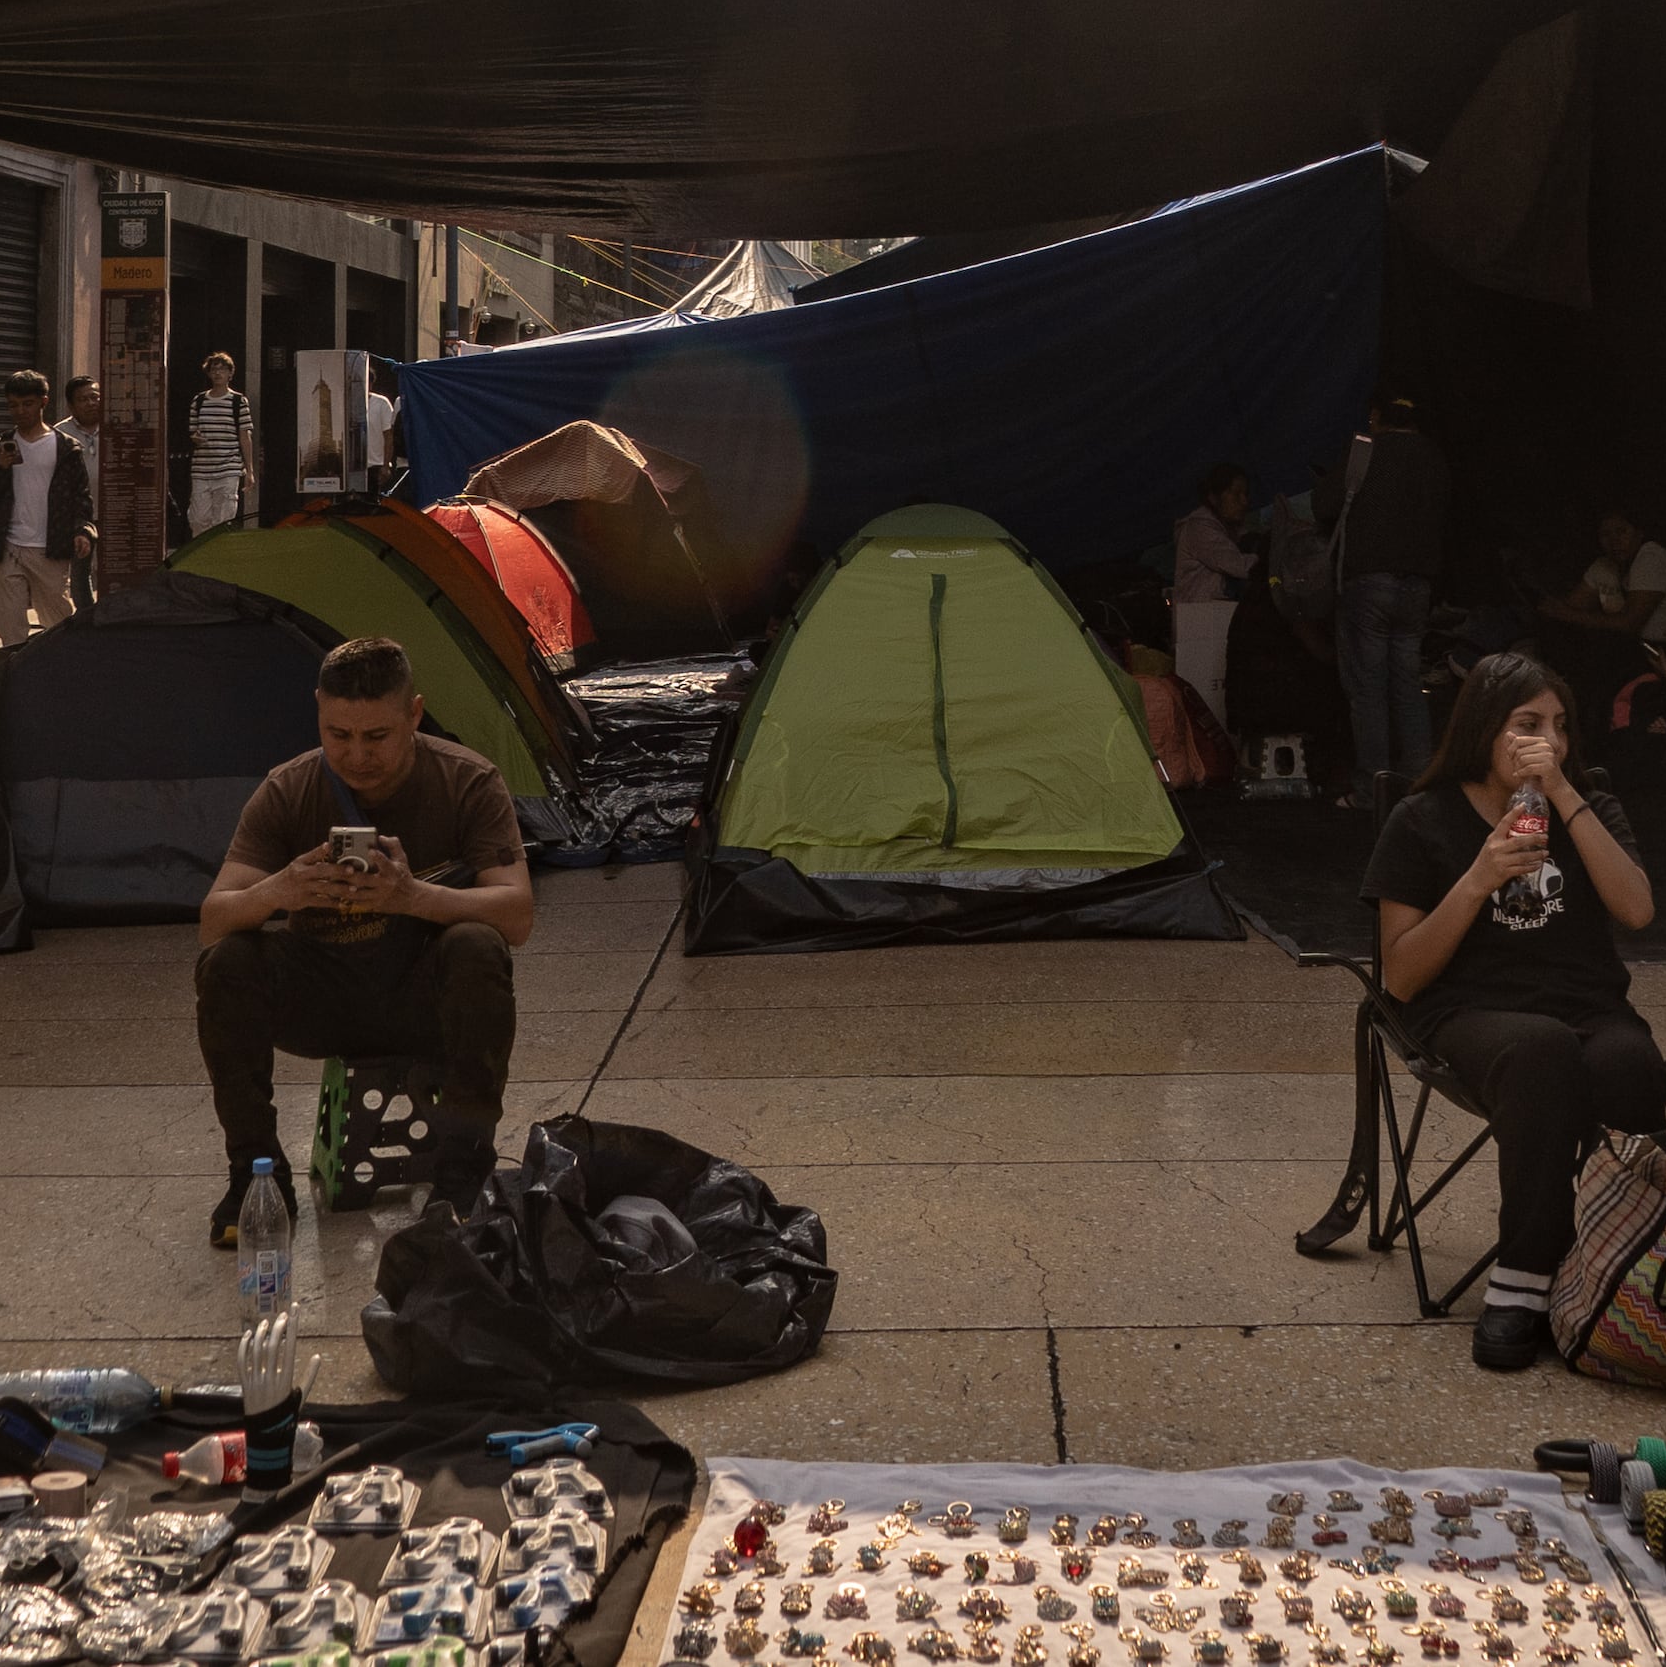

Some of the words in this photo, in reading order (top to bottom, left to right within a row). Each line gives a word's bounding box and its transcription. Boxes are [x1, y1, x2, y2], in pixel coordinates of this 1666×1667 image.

[102, 199, 128, 208] CIUDAD
[129, 199, 138, 208] DE
[139, 197, 164, 207] MÉXICO
[113, 266, 153, 279] Madero
